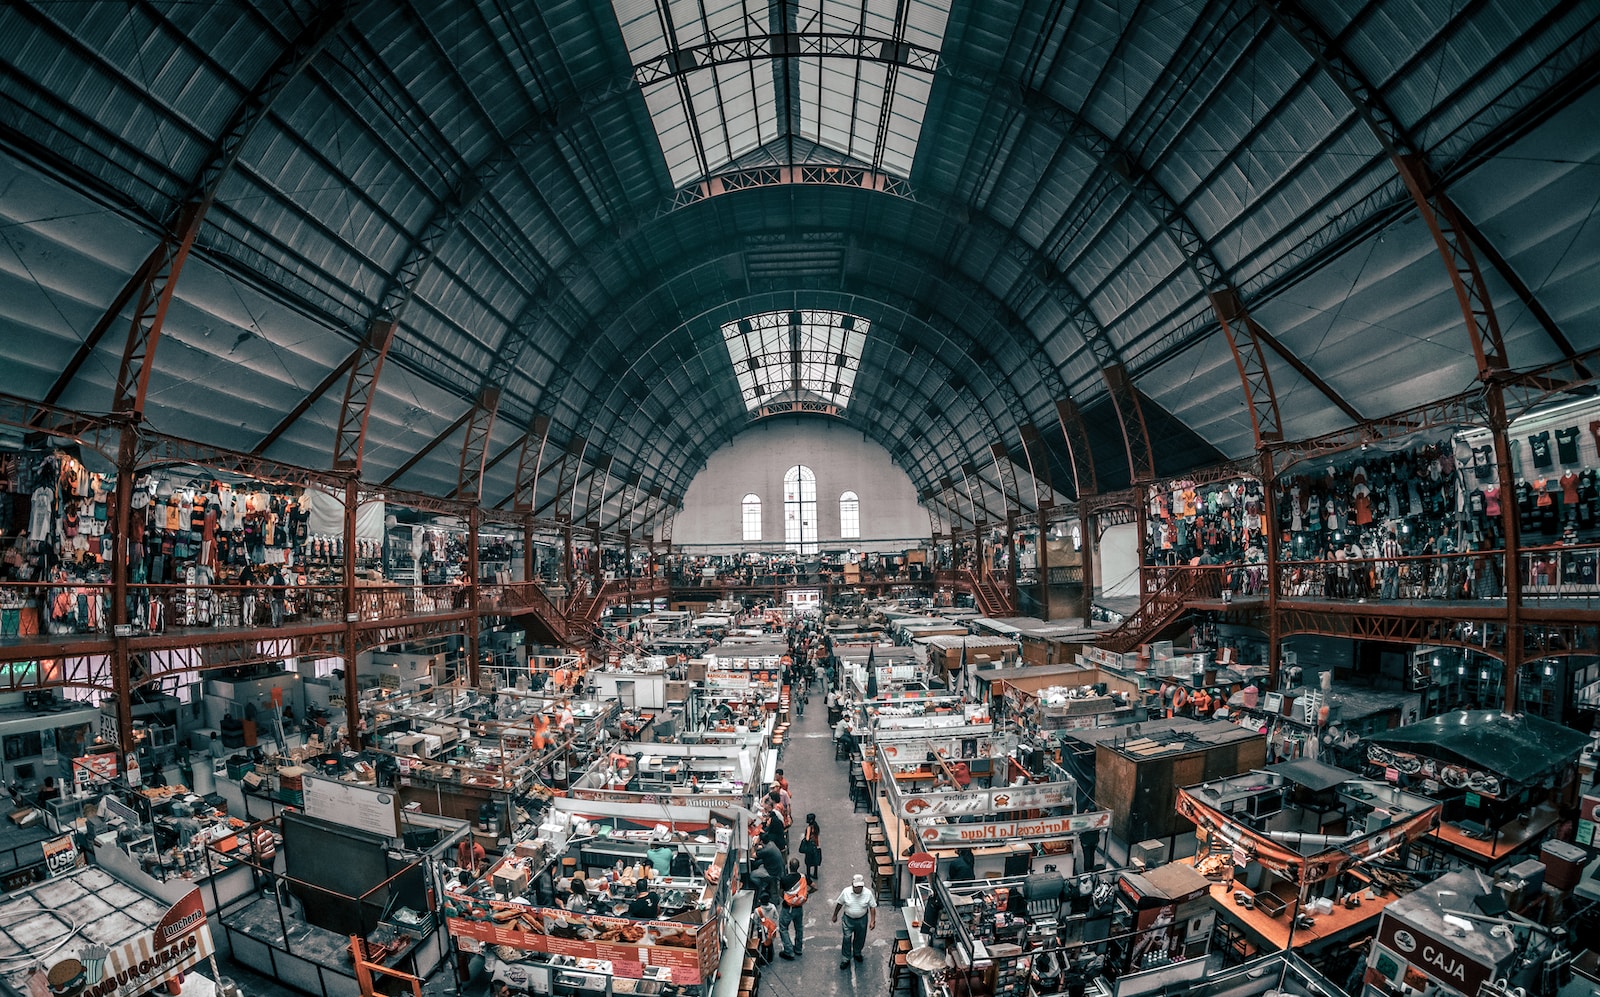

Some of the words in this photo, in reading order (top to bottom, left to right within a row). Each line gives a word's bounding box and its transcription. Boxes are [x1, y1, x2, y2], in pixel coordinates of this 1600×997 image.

[49, 850, 75, 869] USB
[908, 860, 934, 869] Coca-Cola
[543, 908, 571, 917] FILETES
[593, 916, 629, 924] PECHUGAS
[82, 935, 197, 997] AMBURGUESAS
[1422, 946, 1466, 982] CAJA
